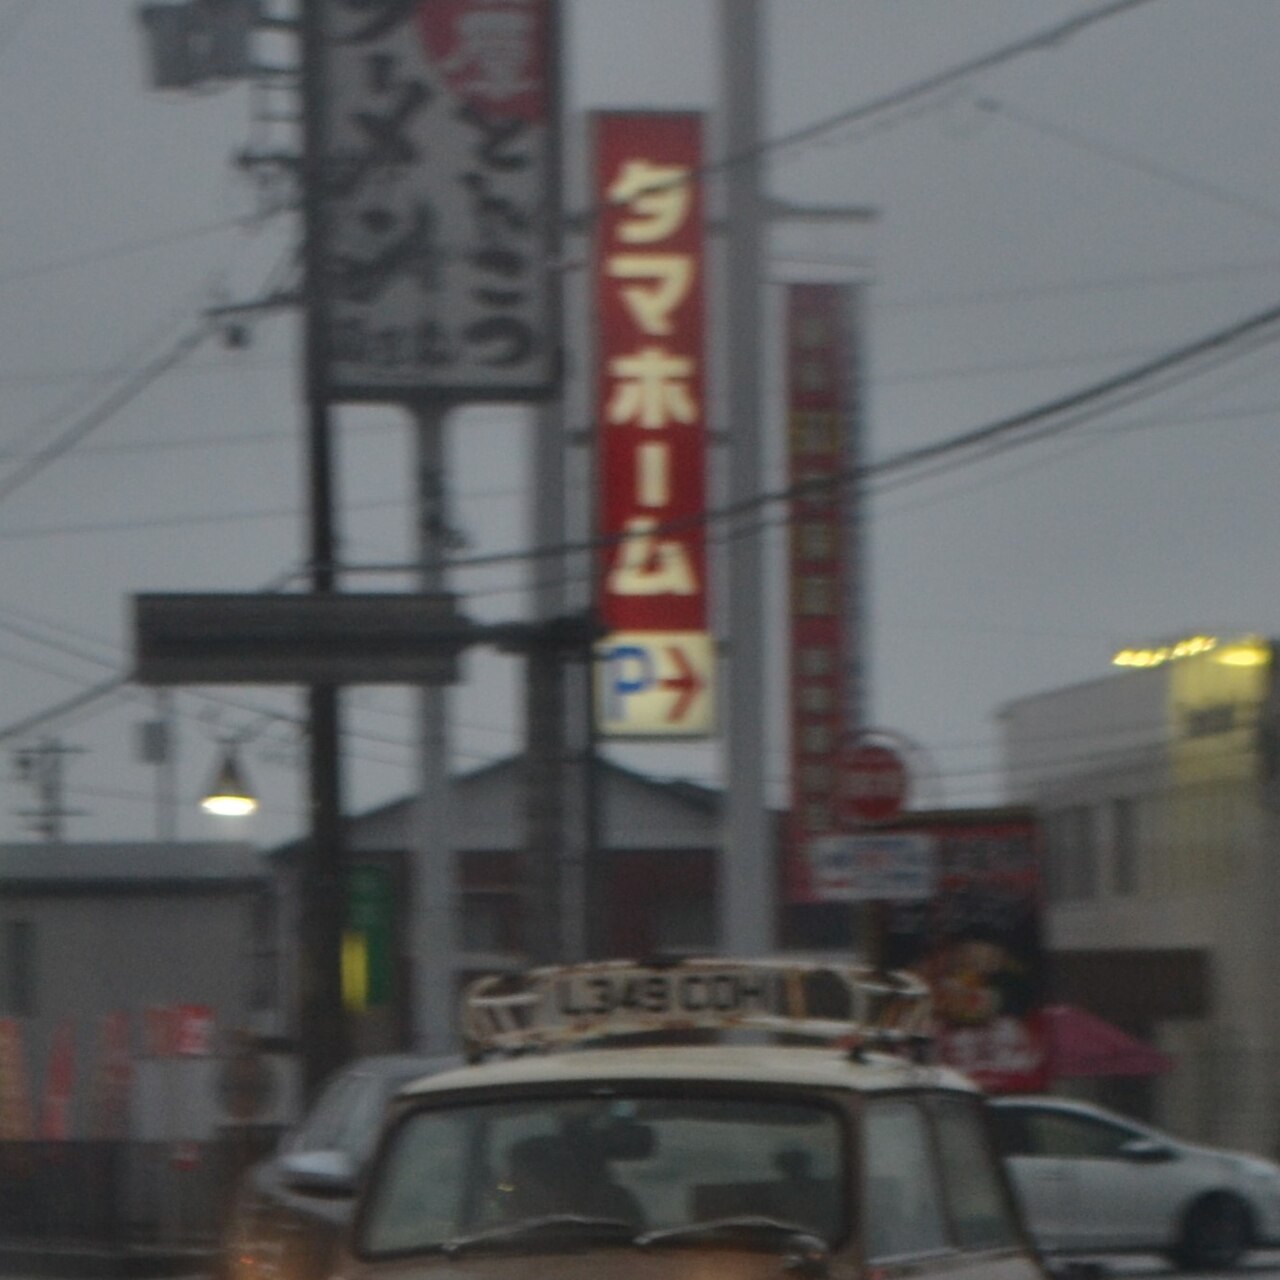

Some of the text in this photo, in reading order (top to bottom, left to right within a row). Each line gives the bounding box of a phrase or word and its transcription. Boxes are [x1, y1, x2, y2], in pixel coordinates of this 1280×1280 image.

[607, 158, 699, 596] タマホーム
